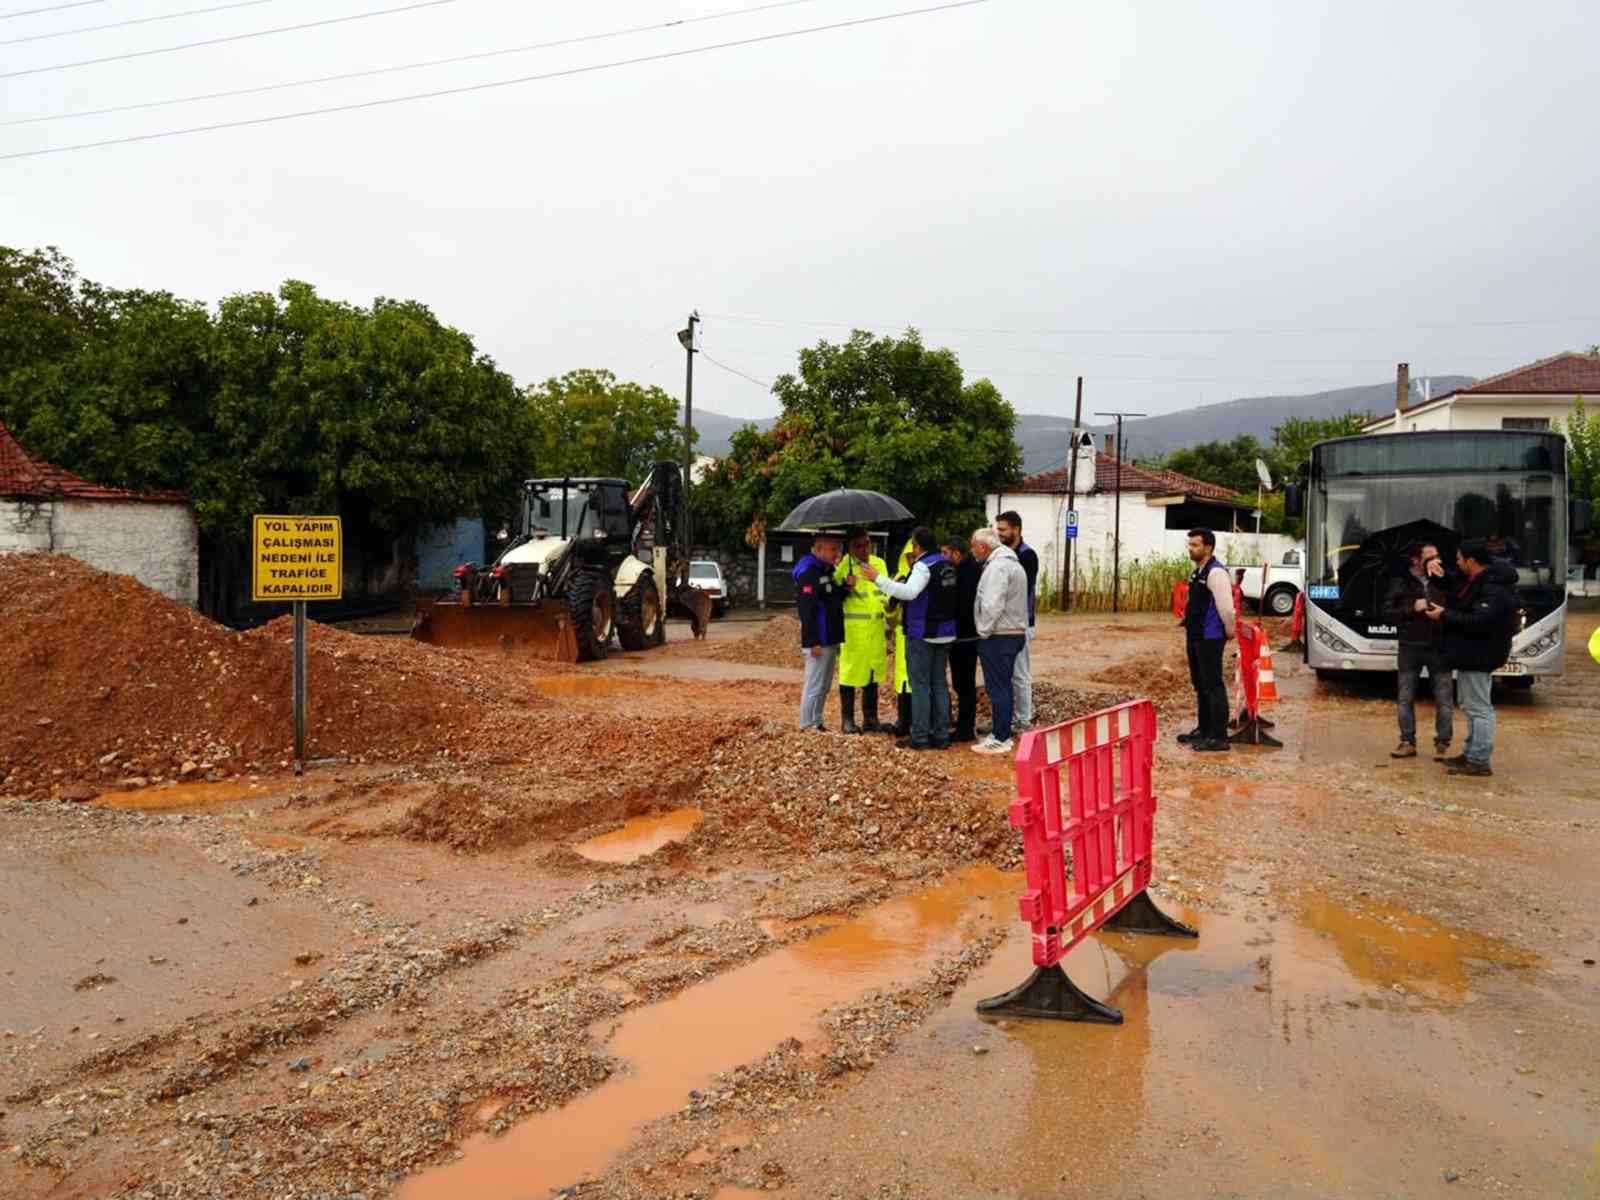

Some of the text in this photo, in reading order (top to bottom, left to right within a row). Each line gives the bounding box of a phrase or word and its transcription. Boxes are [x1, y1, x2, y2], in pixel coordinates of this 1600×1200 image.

[264, 521, 334, 532] YOL YAPIM
[262, 537, 334, 550] ÇALIŞMASI
[261, 551, 336, 563] NEDENİ İLE
[270, 567, 328, 578] TRAFİĞE
[263, 583, 333, 594] KAPALIDIR
